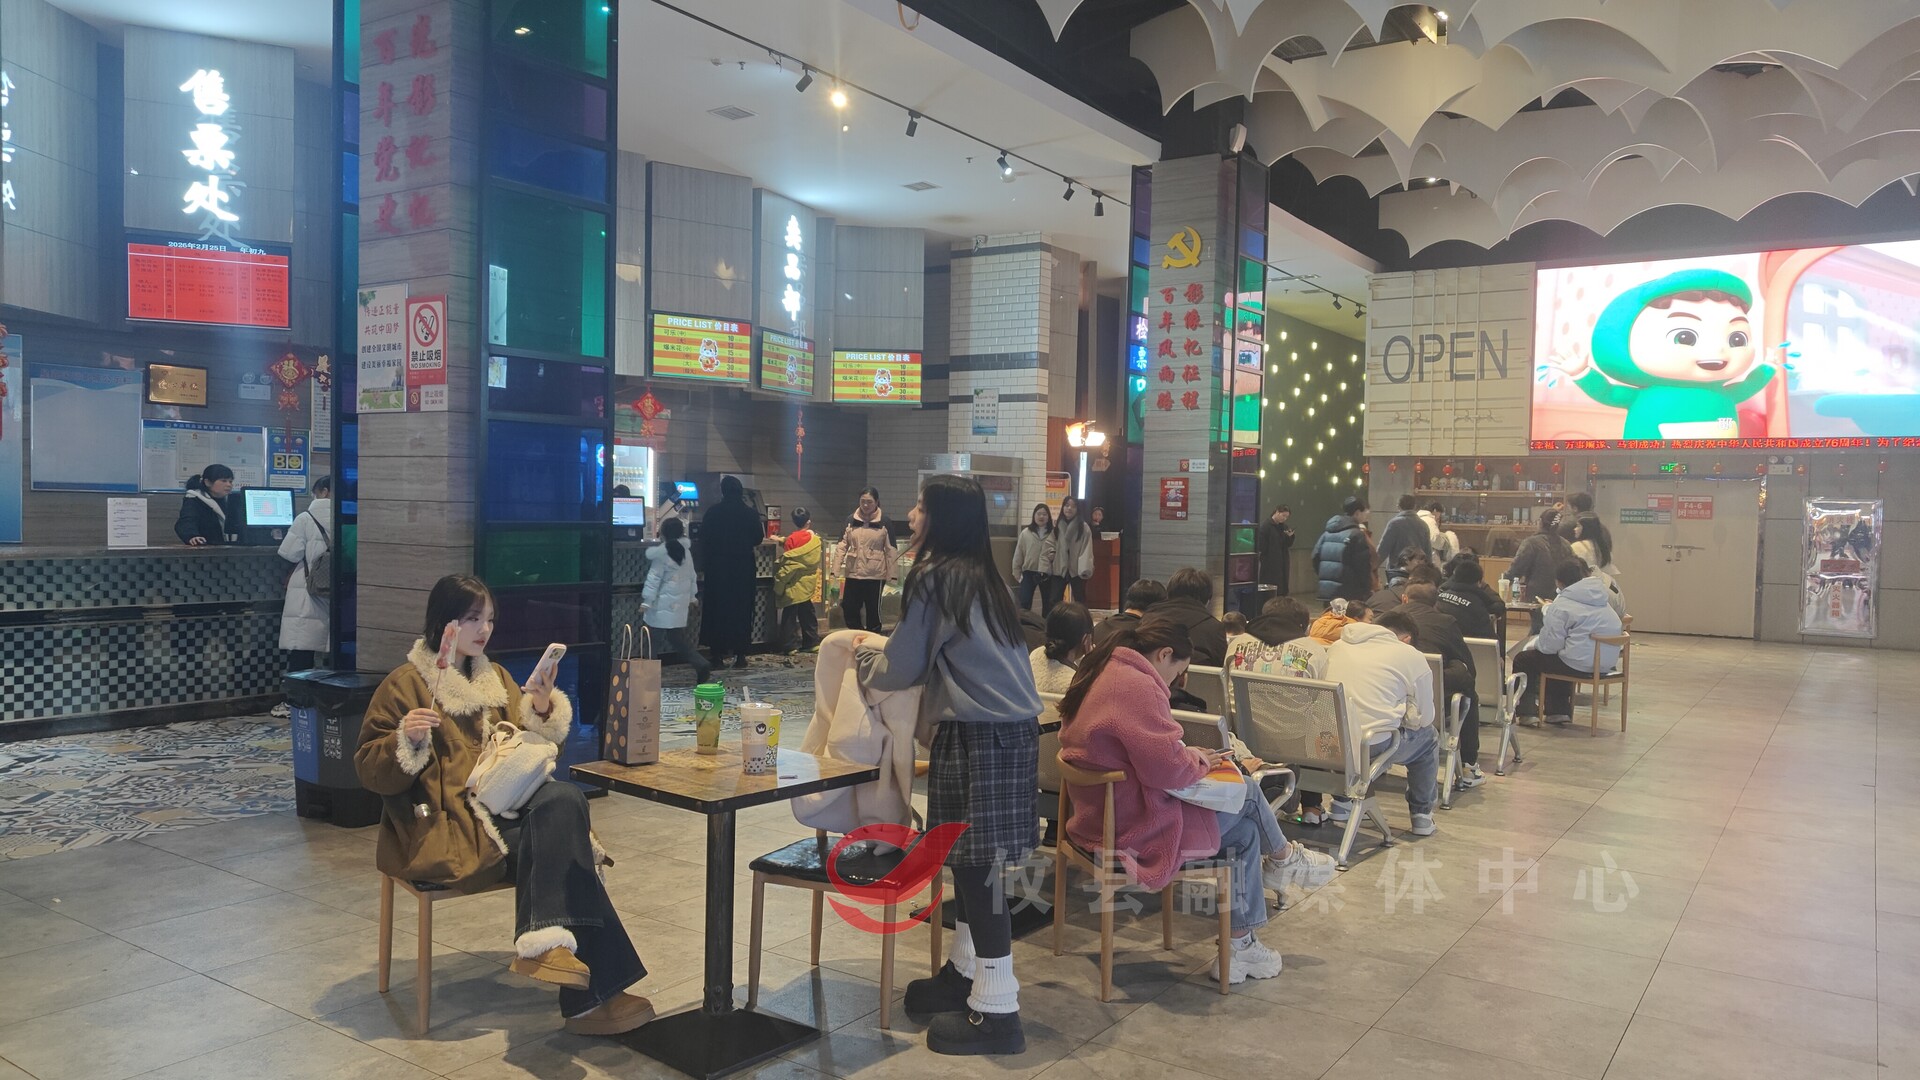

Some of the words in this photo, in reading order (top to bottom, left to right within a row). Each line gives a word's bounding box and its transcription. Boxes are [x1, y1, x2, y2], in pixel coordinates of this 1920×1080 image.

[179, 69, 240, 221] 售票处
[168, 241, 227, 252] 2026年2月25日
[364, 303, 400, 317] 传递正能量
[364, 322, 400, 336] 共筑中国梦
[667, 317, 692, 328] PRICE
[694, 320, 712, 329] LIST
[714, 321, 739, 332] 价目表
[1156, 287, 1178, 411] 百年风雨路
[1181, 282, 1205, 410] 影像忆征程
[411, 349, 442, 362] 禁止吸烟
[869, 353, 886, 361] LIST
[888, 354, 910, 362] 价目表
[1135, 316, 1148, 392] 检票口
[1383, 328, 1508, 384] OPEN
[418, 361, 442, 369] SMOKING
[273, 454, 286, 469] B
